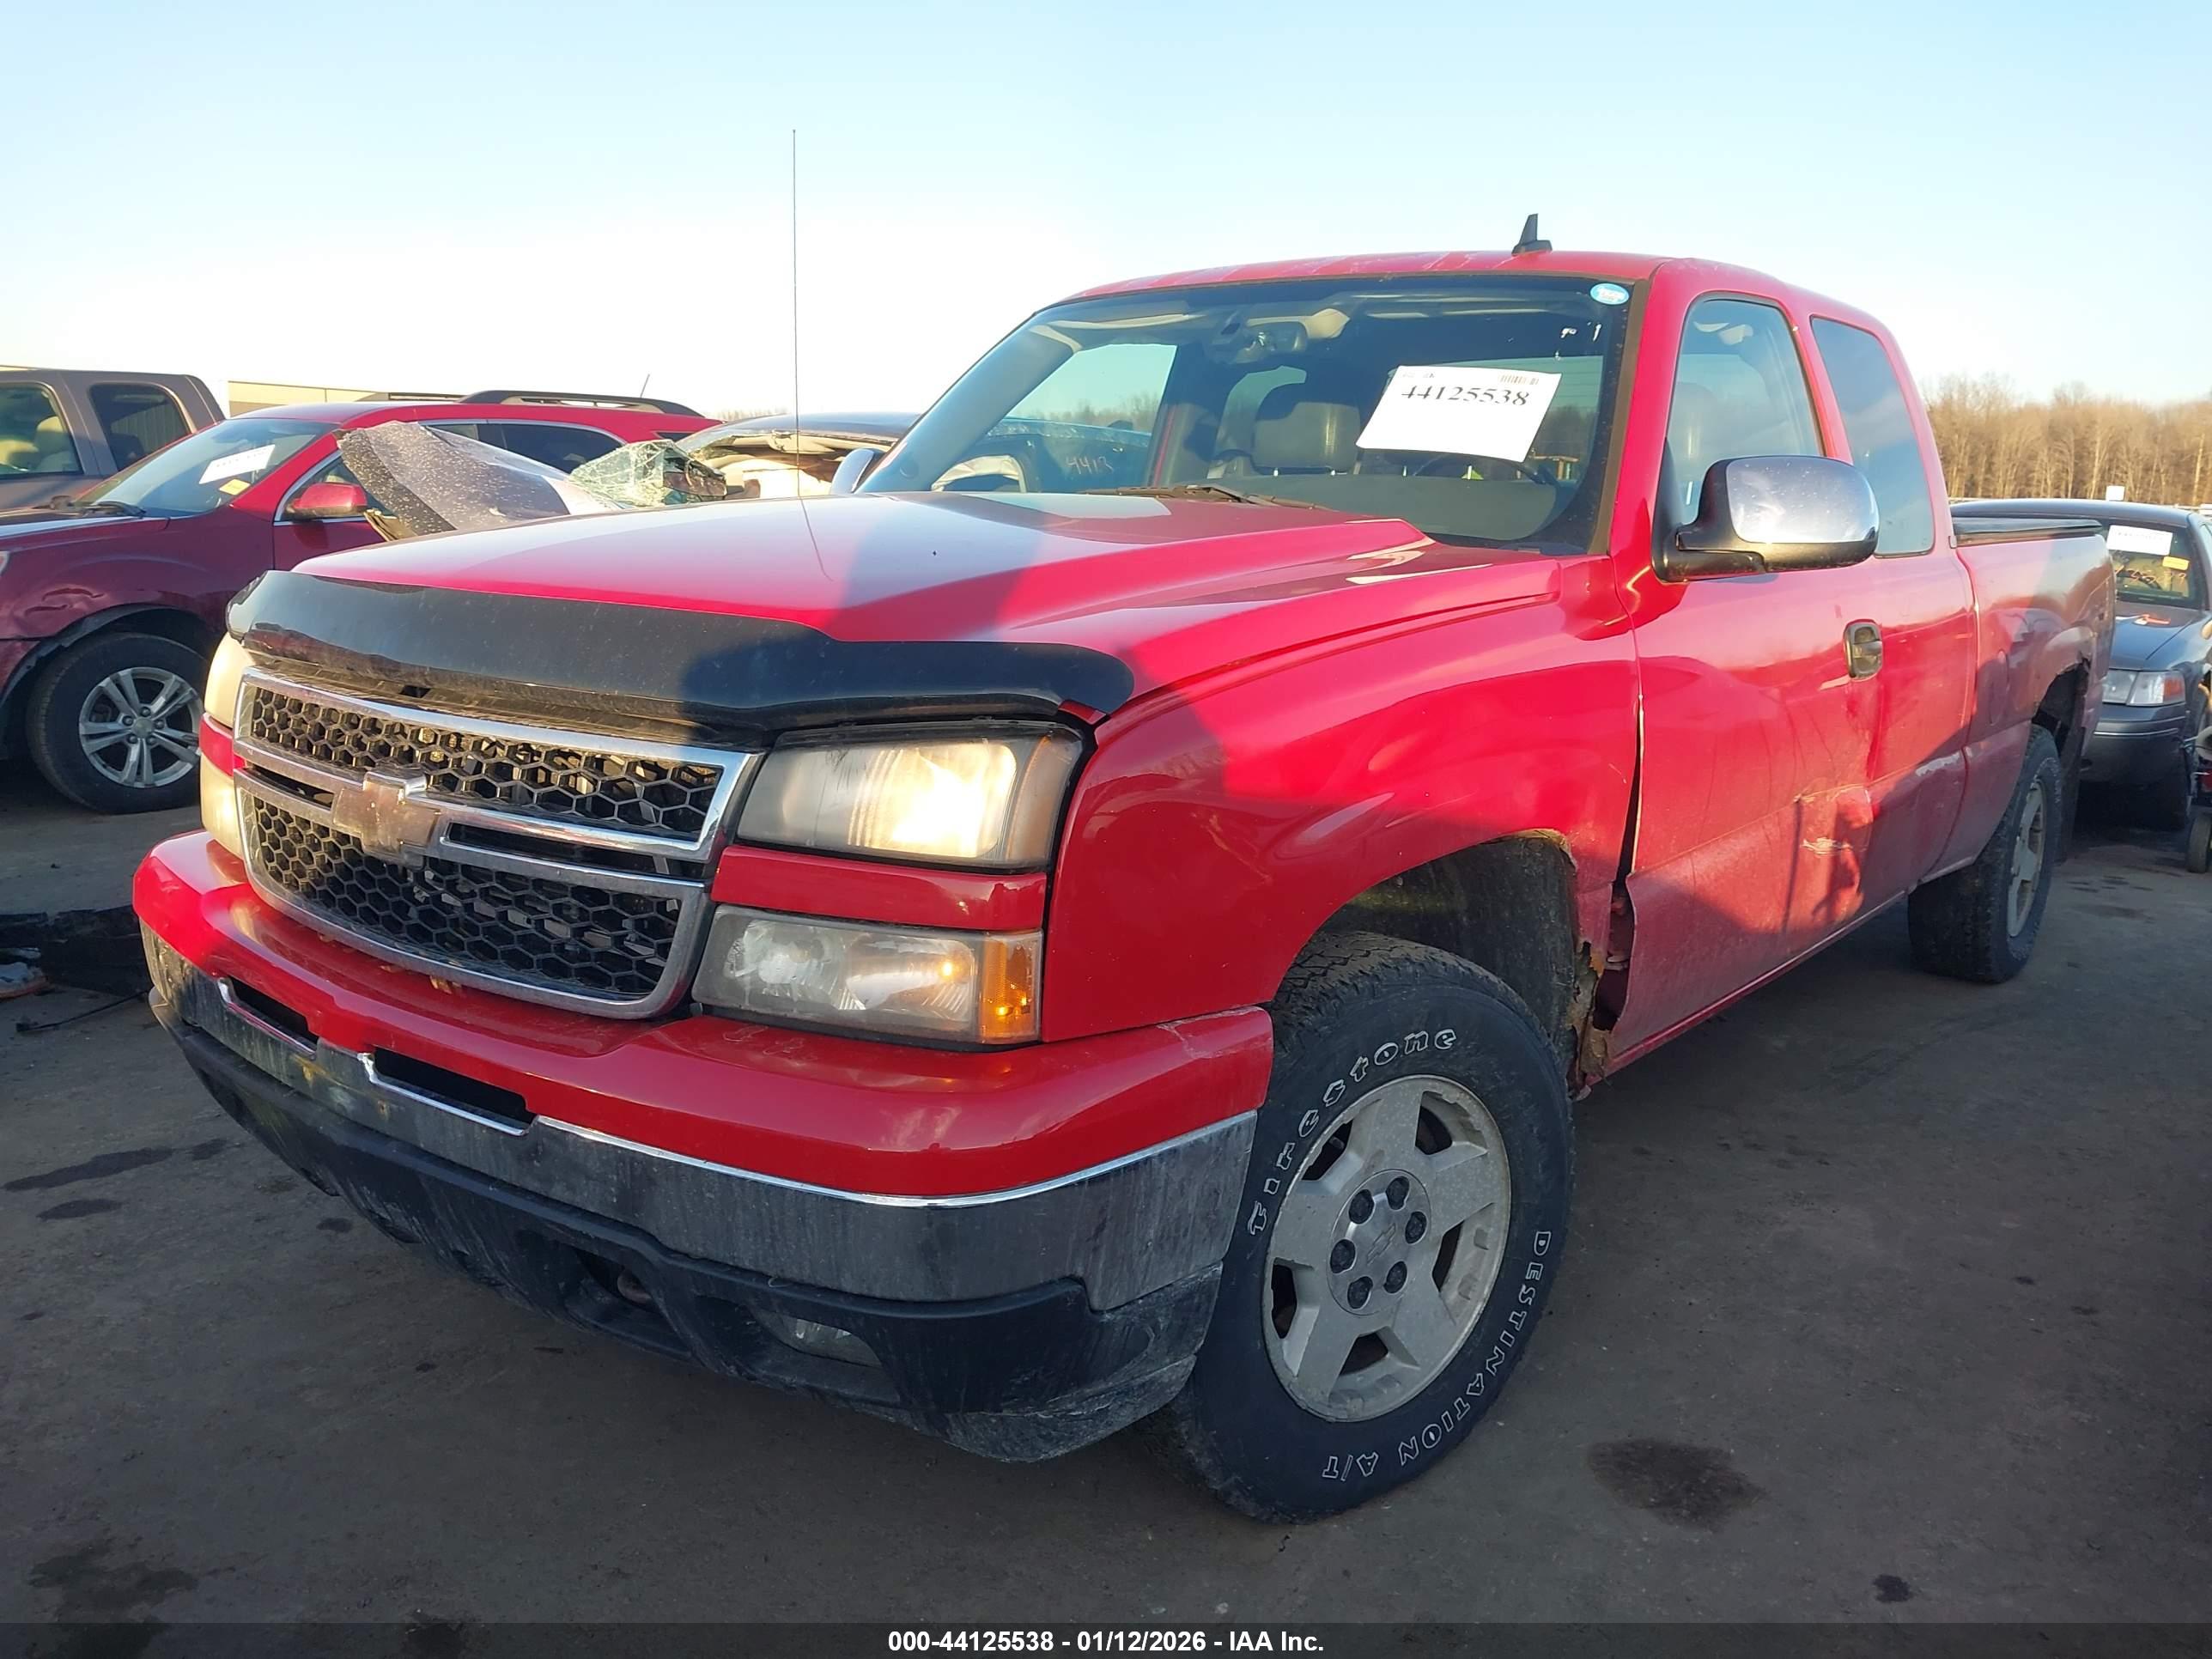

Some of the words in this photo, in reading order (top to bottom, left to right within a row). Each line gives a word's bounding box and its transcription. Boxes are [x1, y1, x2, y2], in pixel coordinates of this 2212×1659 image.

[1401, 386, 1529, 406] 44125538
[1398, 1231, 1552, 1466] DESTINATION
[1322, 1452, 1379, 1481] A/T
